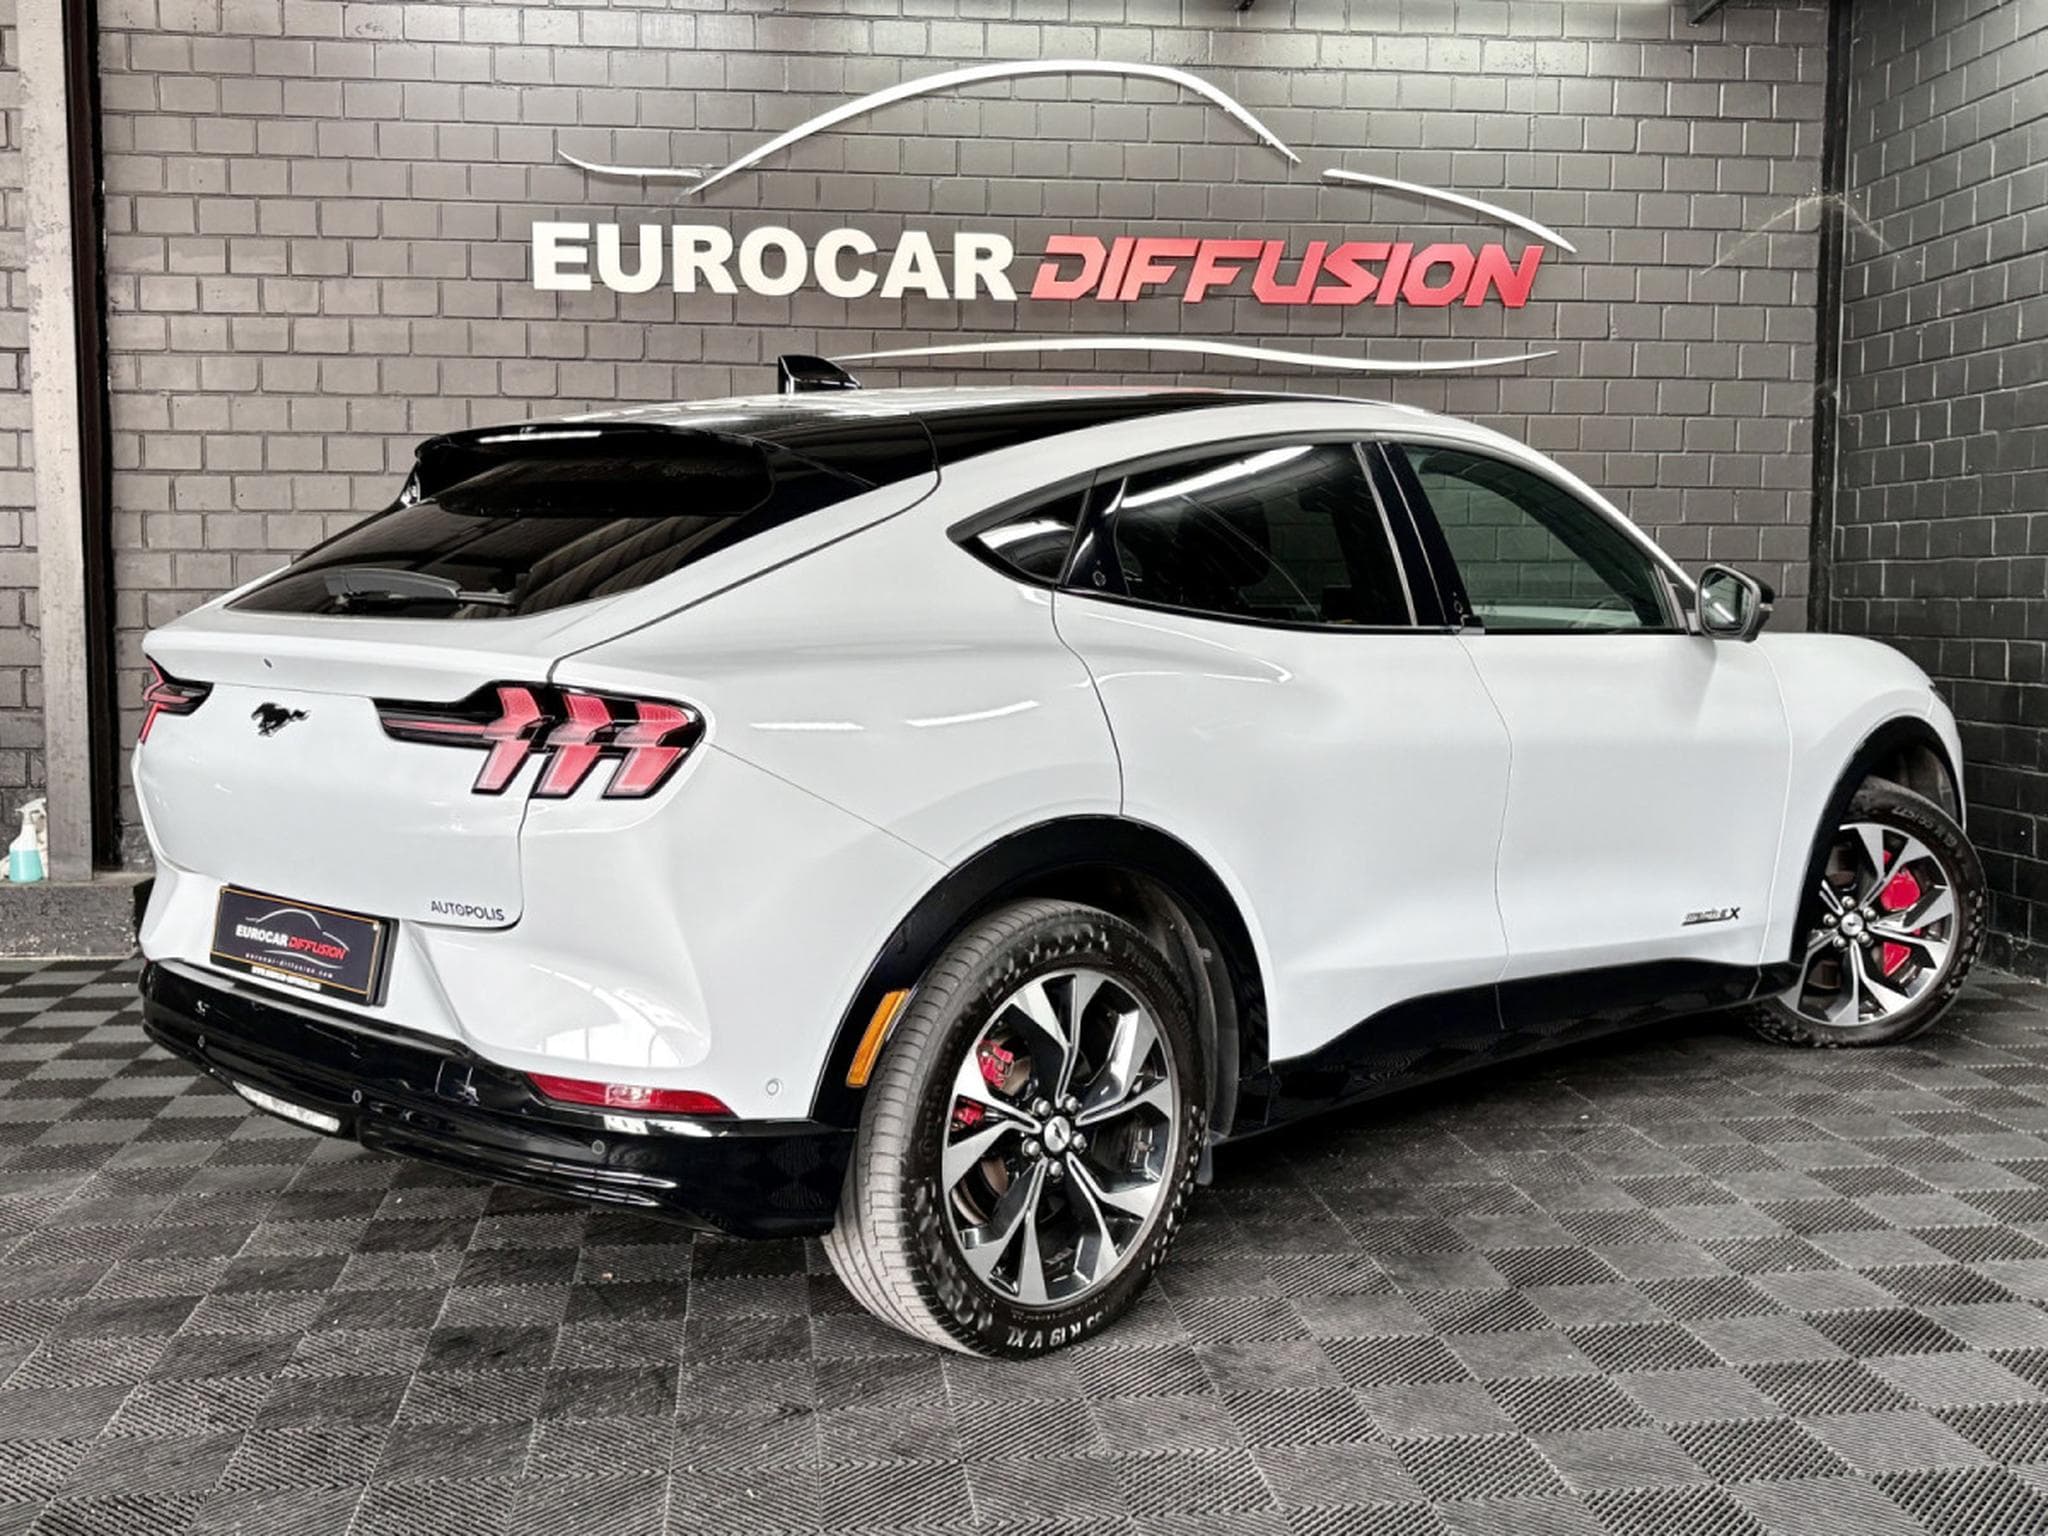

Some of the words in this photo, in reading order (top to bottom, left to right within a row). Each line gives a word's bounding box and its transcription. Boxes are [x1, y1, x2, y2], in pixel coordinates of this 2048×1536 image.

[531, 221, 1018, 301] EUROCAR
[1030, 234, 1545, 308] DIFFUSION
[431, 900, 505, 921] AUTOPOLIS
[235, 923, 288, 948] EUROCAR
[288, 936, 347, 961] DIFFUSION
